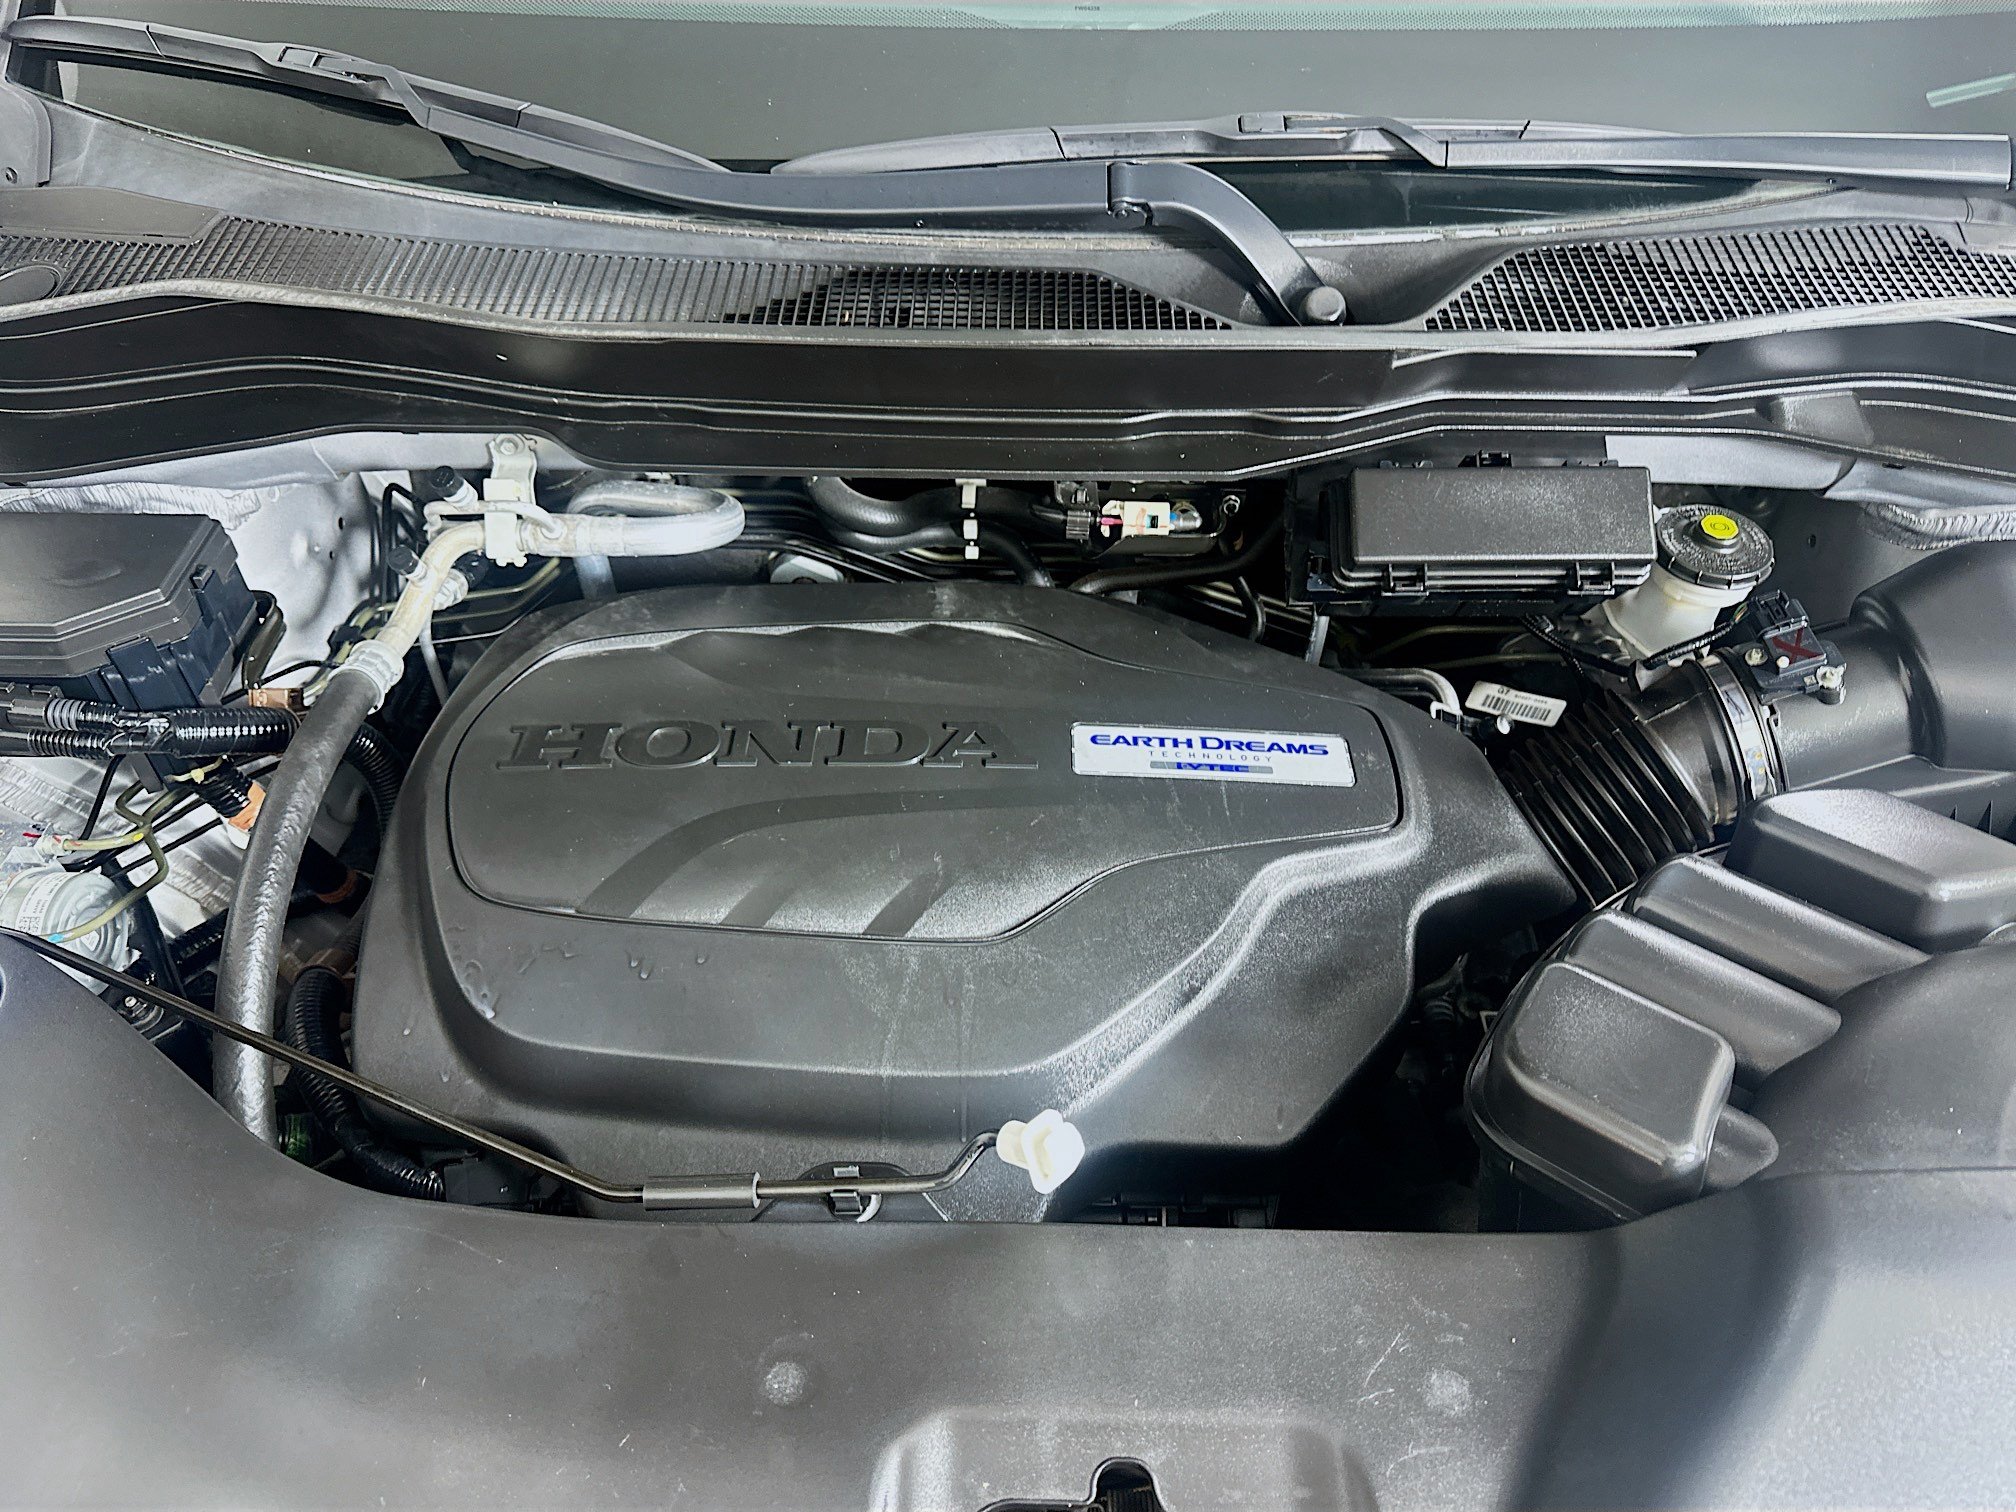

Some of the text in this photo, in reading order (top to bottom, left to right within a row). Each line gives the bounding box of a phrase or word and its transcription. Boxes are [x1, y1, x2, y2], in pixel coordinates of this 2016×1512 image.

[497, 720, 1038, 769] HONDA
[1091, 735, 1193, 750] EARTH
[1149, 750, 1272, 763] TECHNOLOGY
